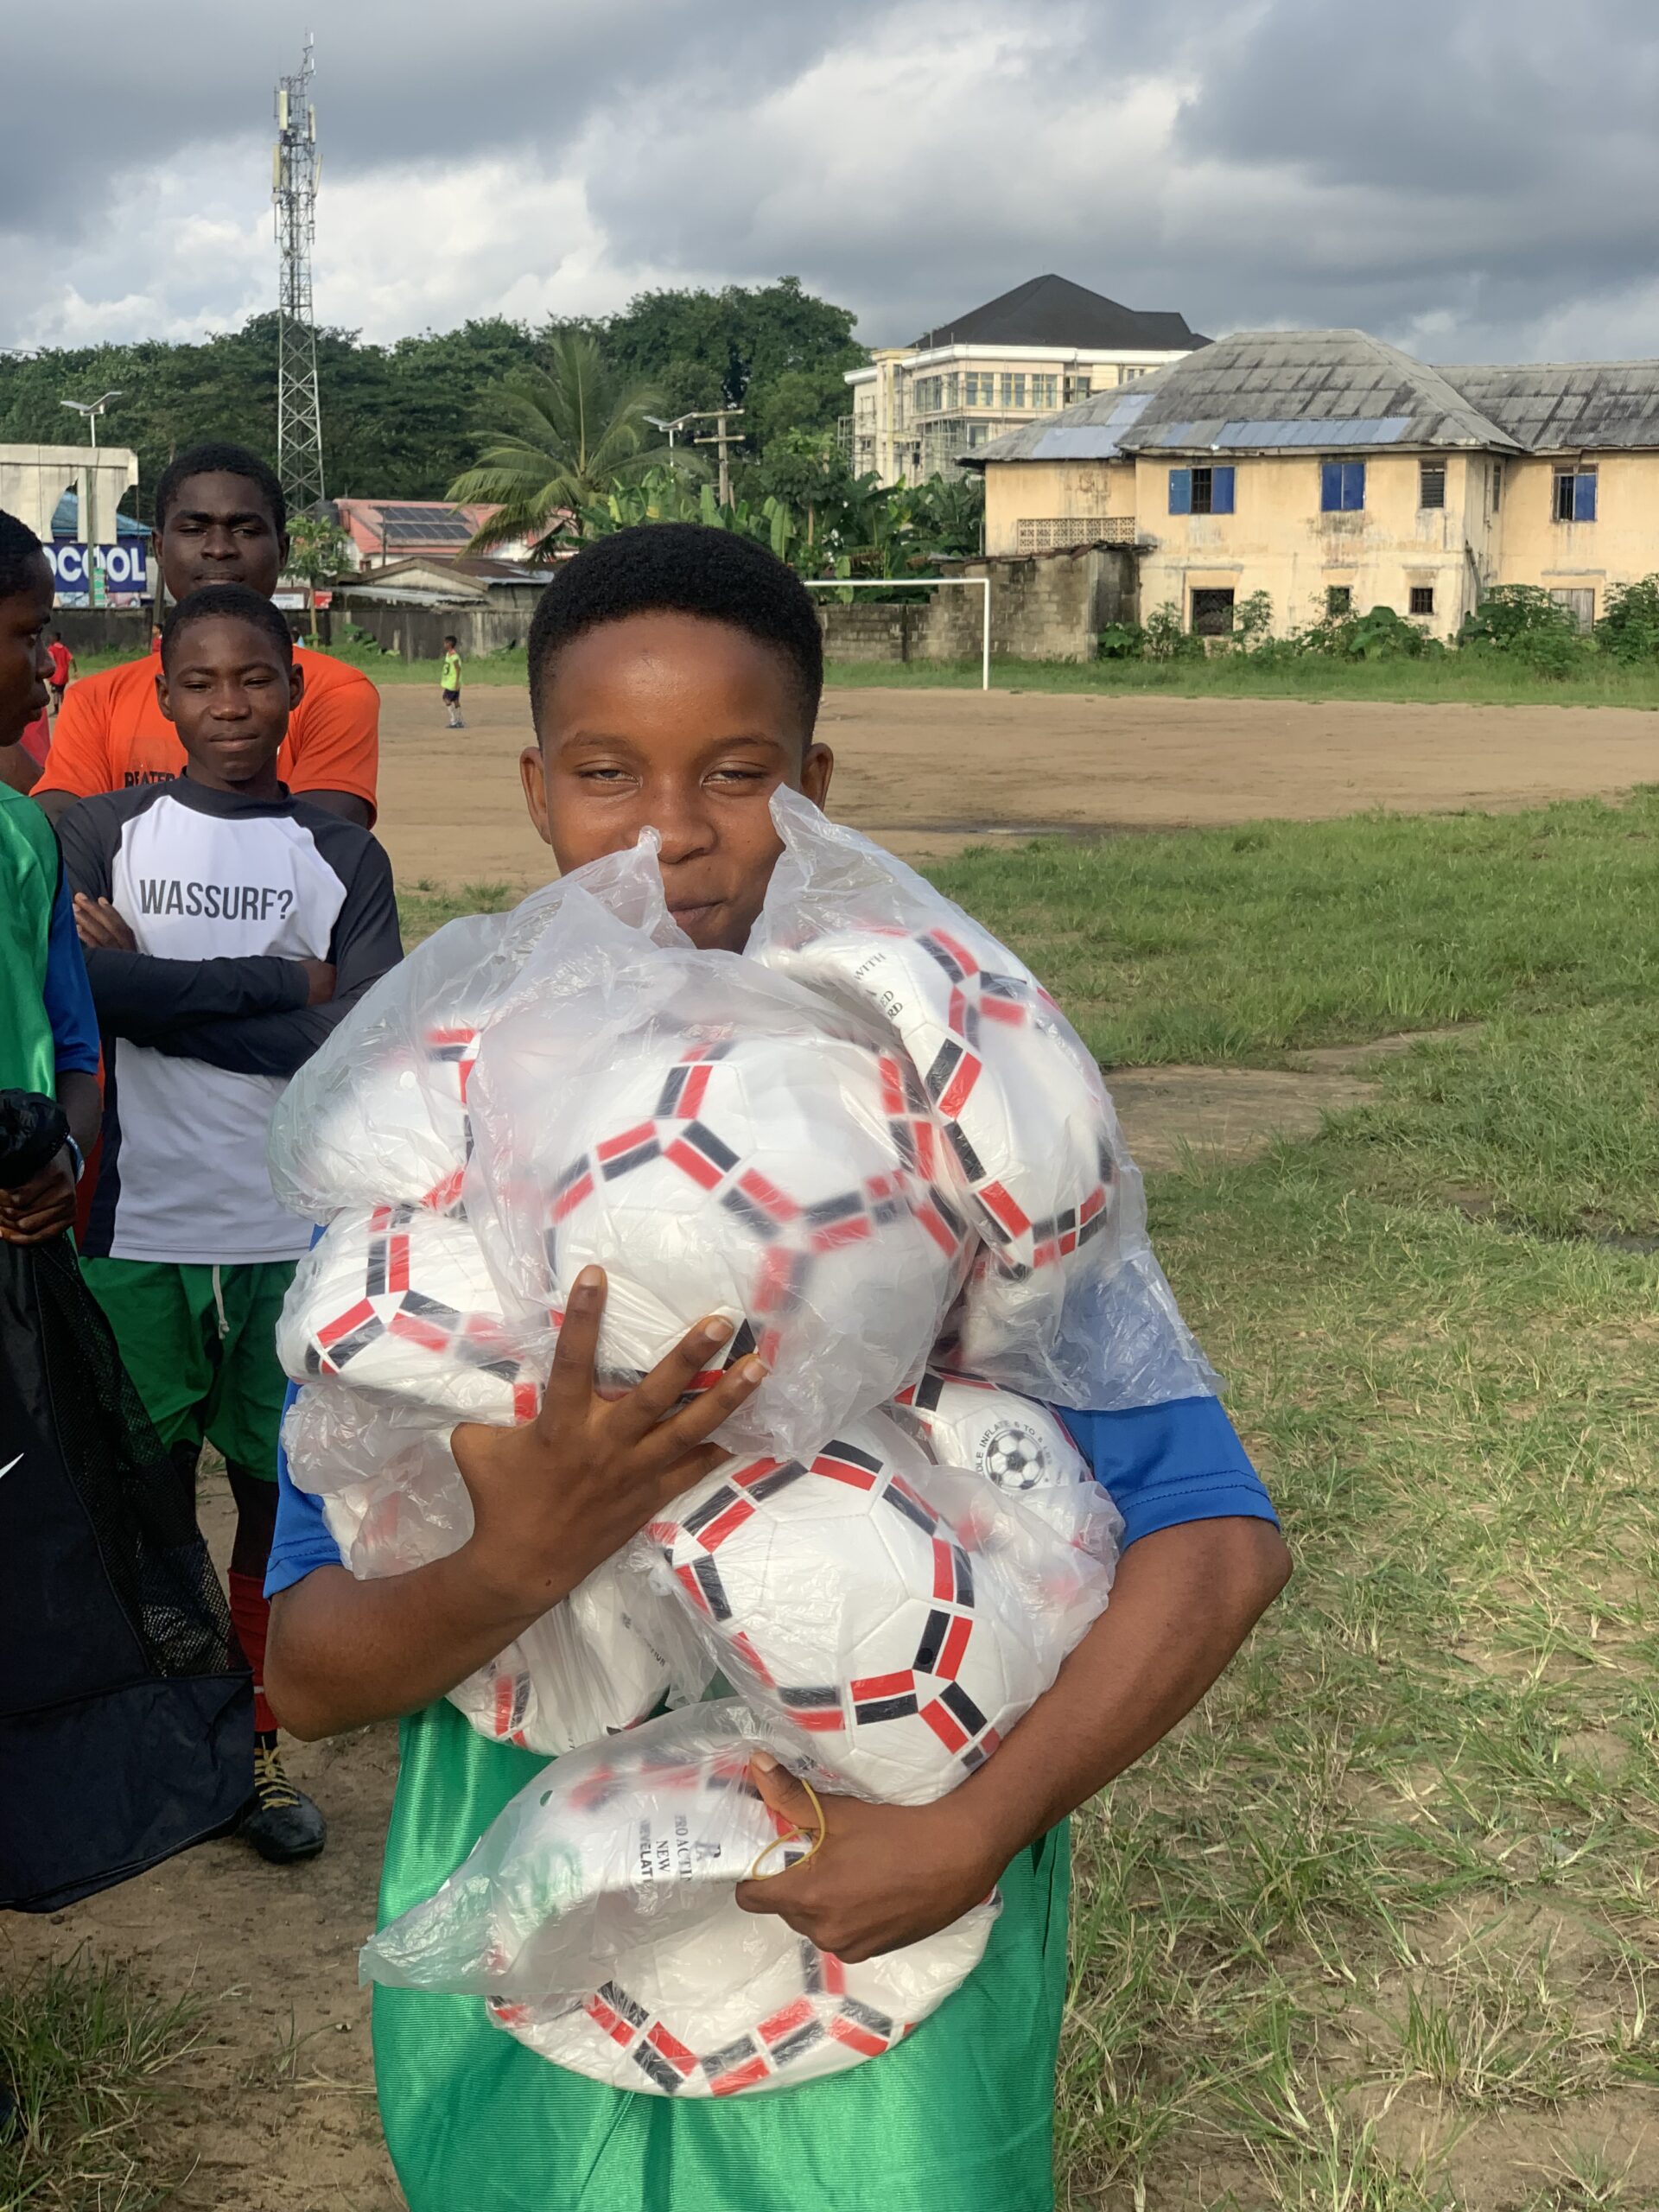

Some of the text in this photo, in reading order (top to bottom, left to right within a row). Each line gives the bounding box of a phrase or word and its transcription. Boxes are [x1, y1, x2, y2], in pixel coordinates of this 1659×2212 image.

[139, 879, 294, 921] WASSURF?
[854, 952, 886, 980] WITH
[1024, 1424, 1035, 1435] TO
[656, 1840, 671, 1872] NEW
